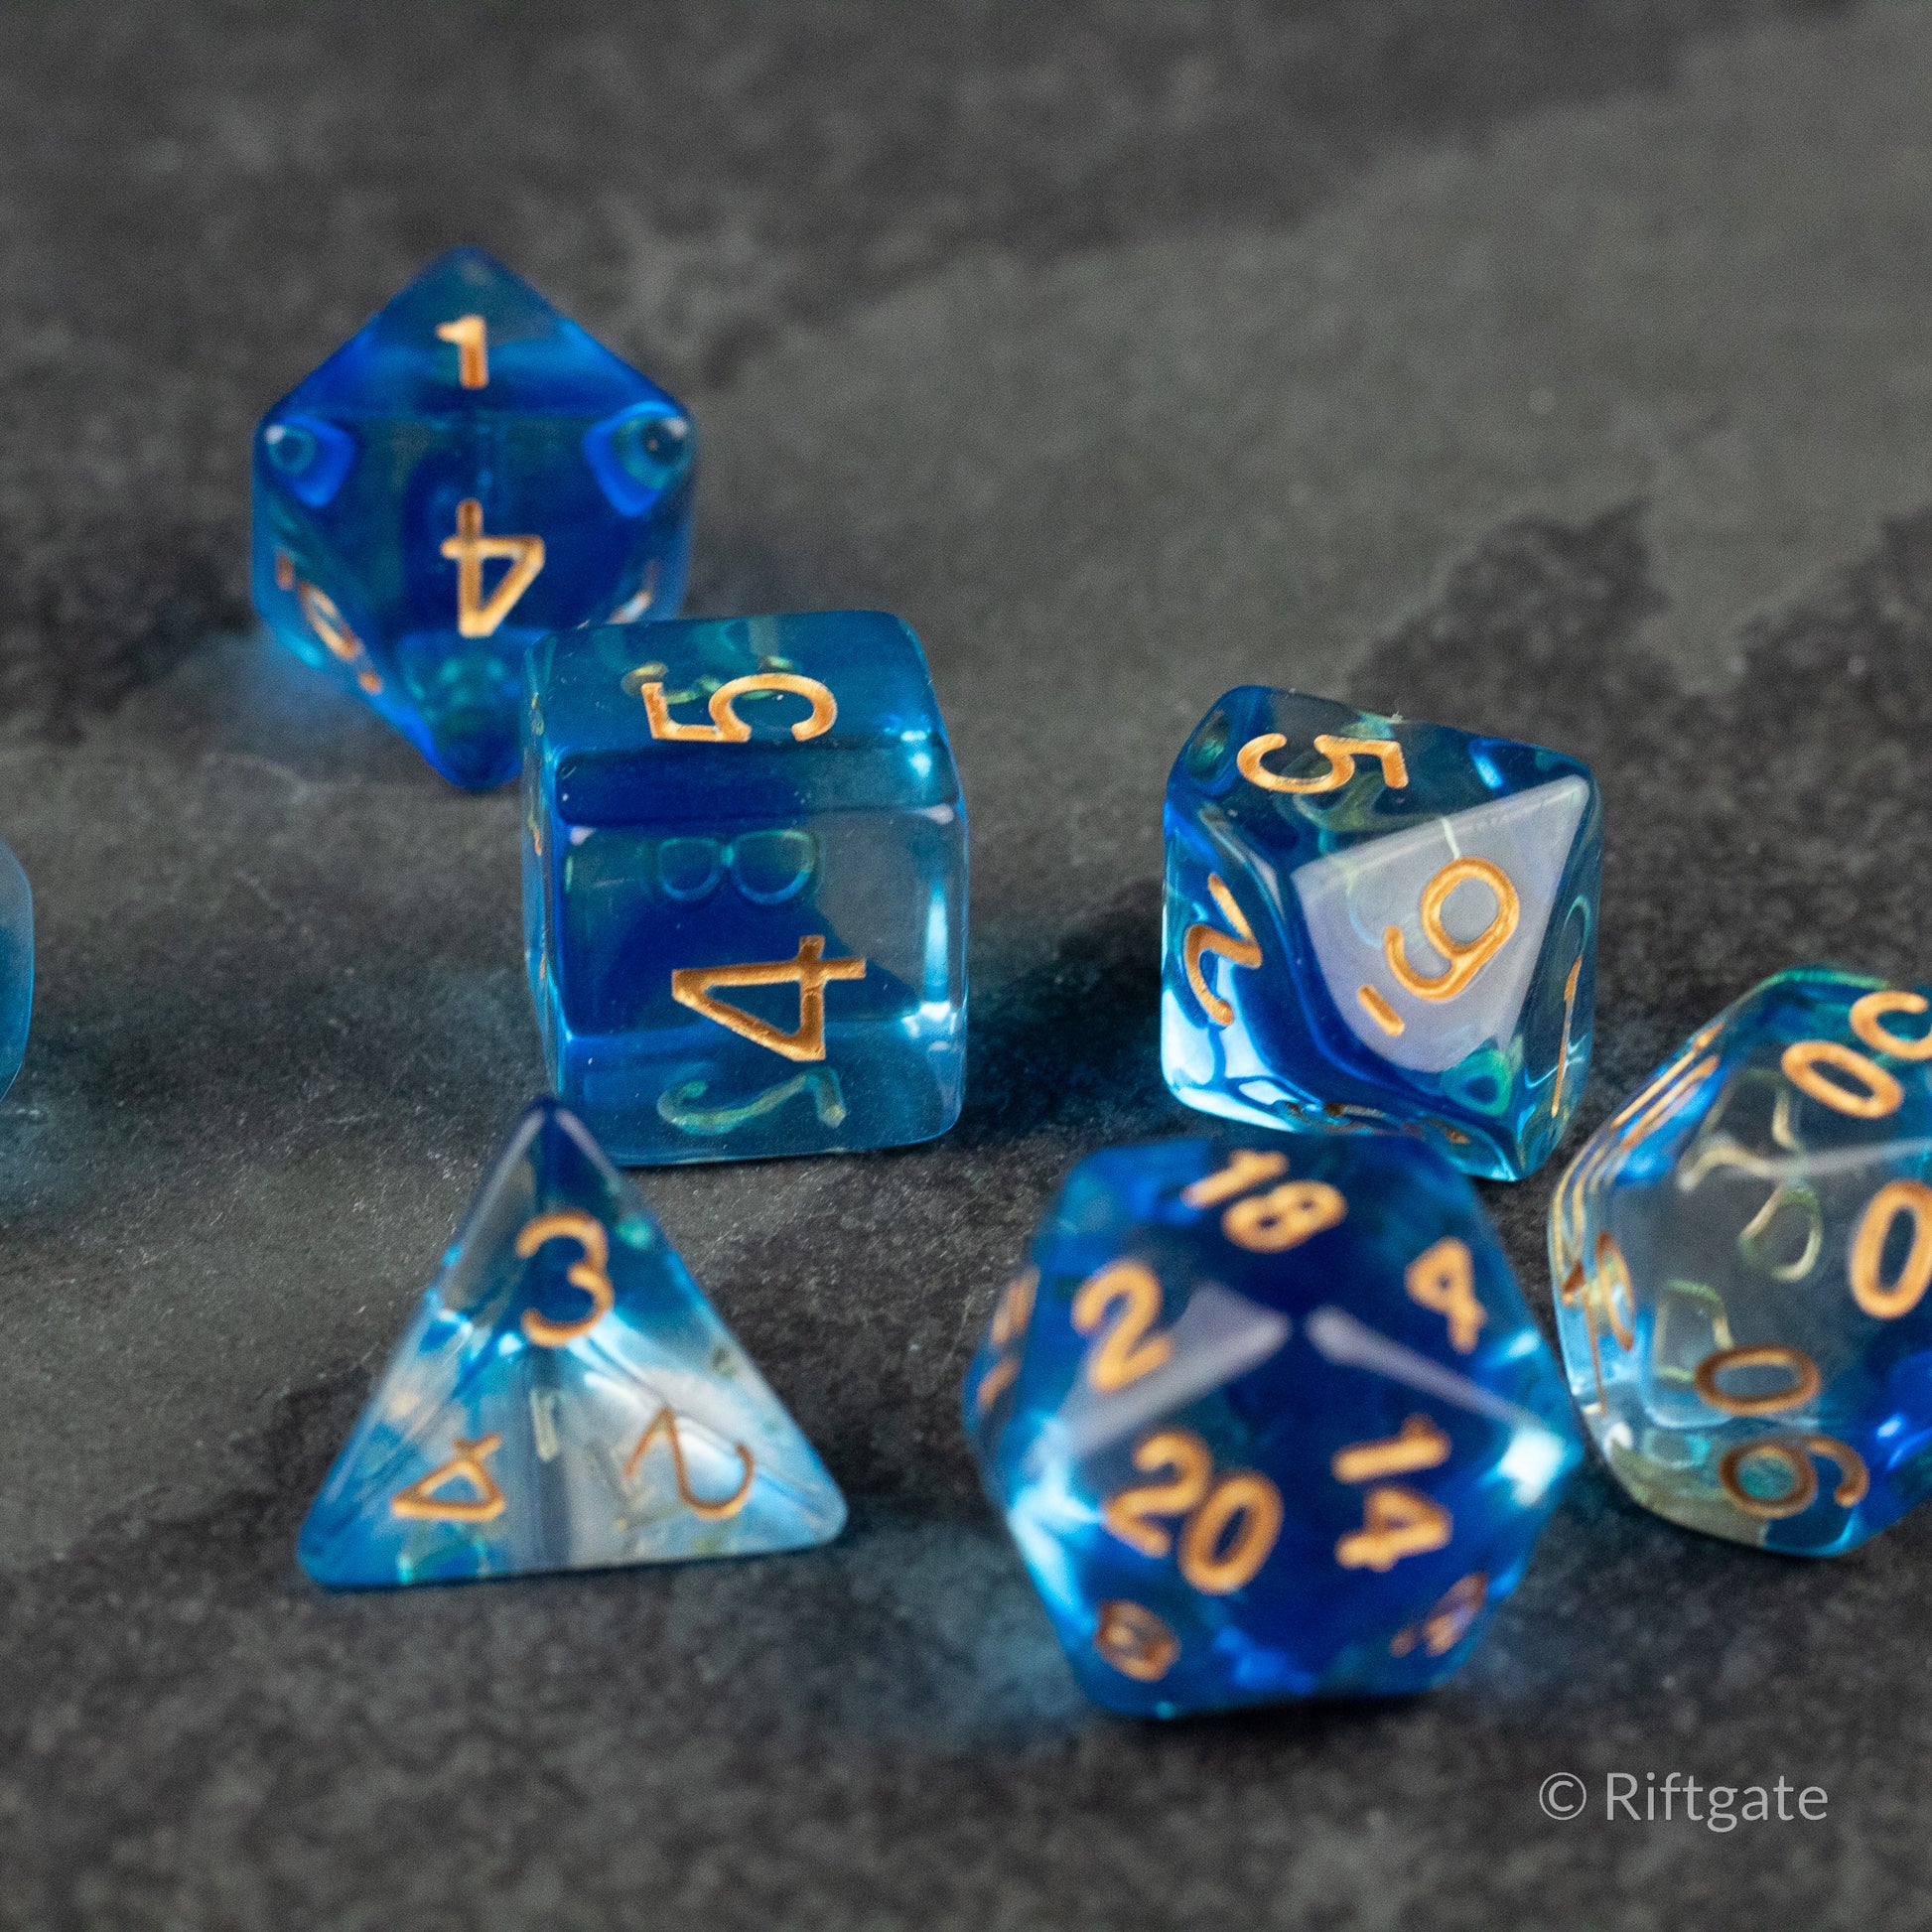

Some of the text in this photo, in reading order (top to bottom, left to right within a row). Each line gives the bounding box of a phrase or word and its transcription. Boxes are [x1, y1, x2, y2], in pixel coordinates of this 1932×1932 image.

[436, 315, 487, 389] 1
[440, 498, 546, 638] 4
[641, 672, 838, 743] 5
[1237, 733, 1409, 793] 5
[672, 935, 867, 1061] 4
[1180, 1149, 1348, 1254] 18
[515, 1210, 614, 1348] 3
[1070, 1258, 1174, 1393] 2
[1405, 1236, 1486, 1355] 4
[390, 1432, 505, 1522] 4
[1100, 1427, 1284, 1596] 20
[1330, 1412, 1453, 1574] 14
